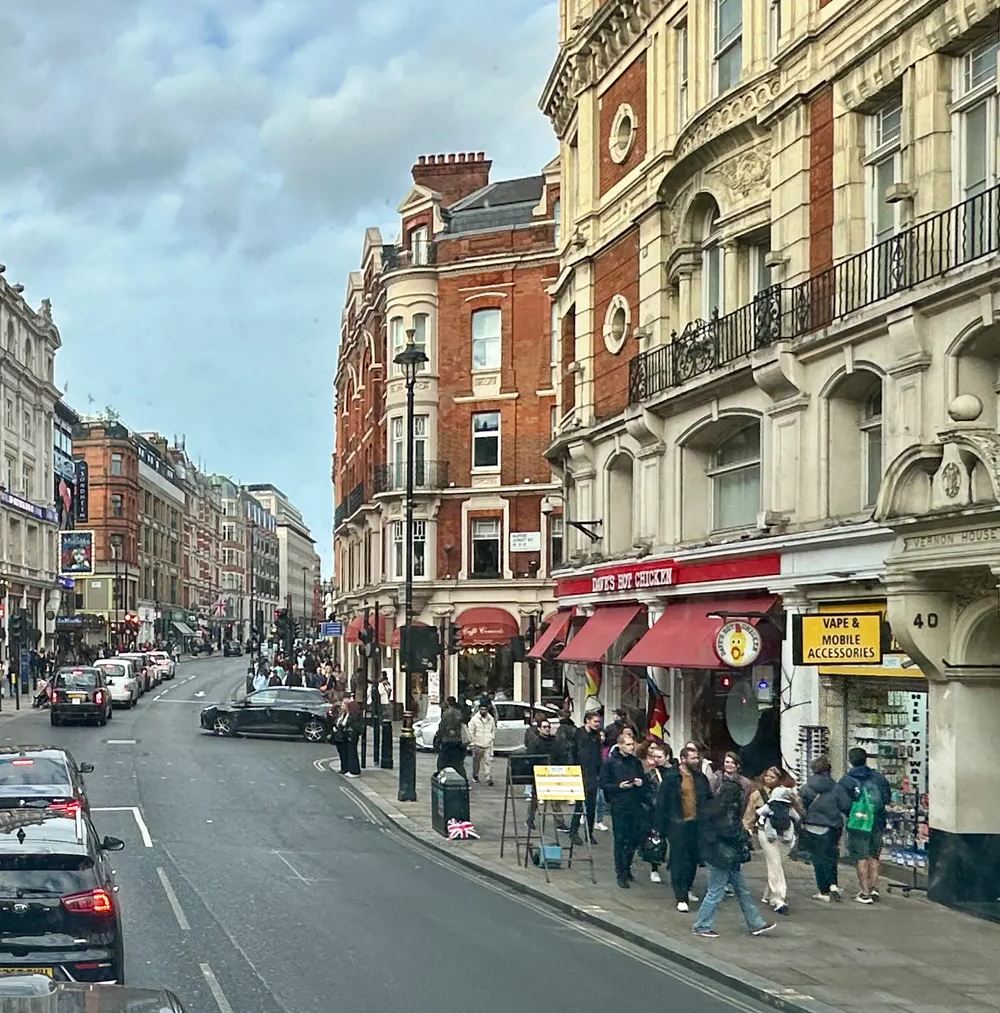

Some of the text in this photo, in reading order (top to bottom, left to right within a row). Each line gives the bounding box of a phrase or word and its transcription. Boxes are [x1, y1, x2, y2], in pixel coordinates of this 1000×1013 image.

[913, 529, 996, 548] VERNON HOUSE
[592, 568, 673, 592] DAVE'S HOT CHICKEN
[823, 617, 860, 628] VAPE &
[913, 613, 938, 629] 40
[741, 623, 759, 652] CHICKEN
[822, 634, 860, 645] MOBILE
[808, 647, 875, 658] ACCESSORIES
